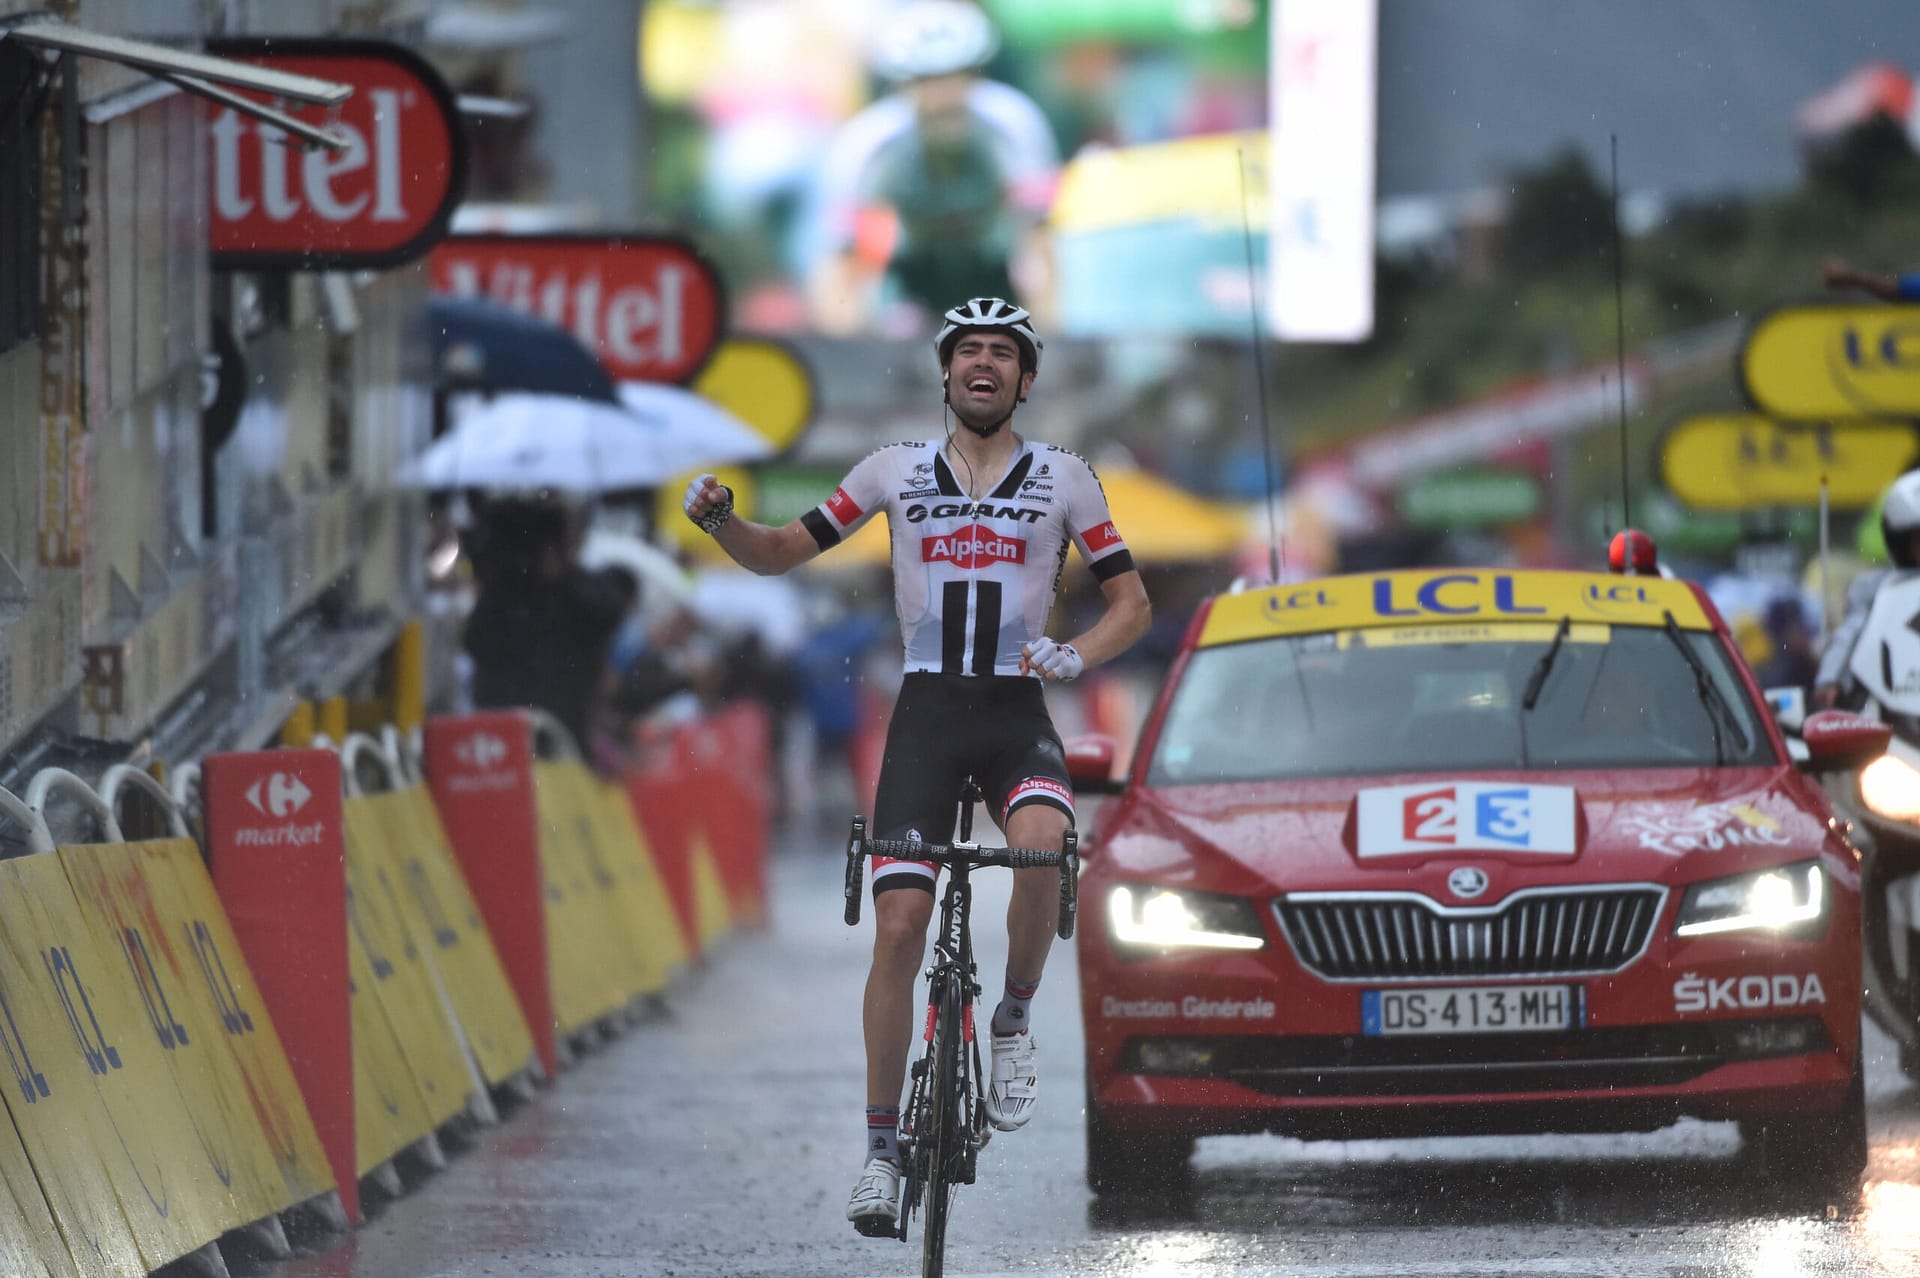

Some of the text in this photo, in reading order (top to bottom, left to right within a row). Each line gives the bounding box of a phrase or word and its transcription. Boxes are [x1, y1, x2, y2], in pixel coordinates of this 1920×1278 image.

[1036, 483, 1054, 492] DSM
[931, 503, 1048, 523] GIANT
[930, 537, 1017, 561] Alpecin
[1268, 575, 1658, 616] LCL LCL LCL
[1019, 779, 1070, 799] Alpecin
[1412, 795, 1530, 840] 2 3
[235, 821, 325, 847] market
[950, 890, 962, 953] GIANT
[1673, 971, 1827, 1012] ŠKODA
